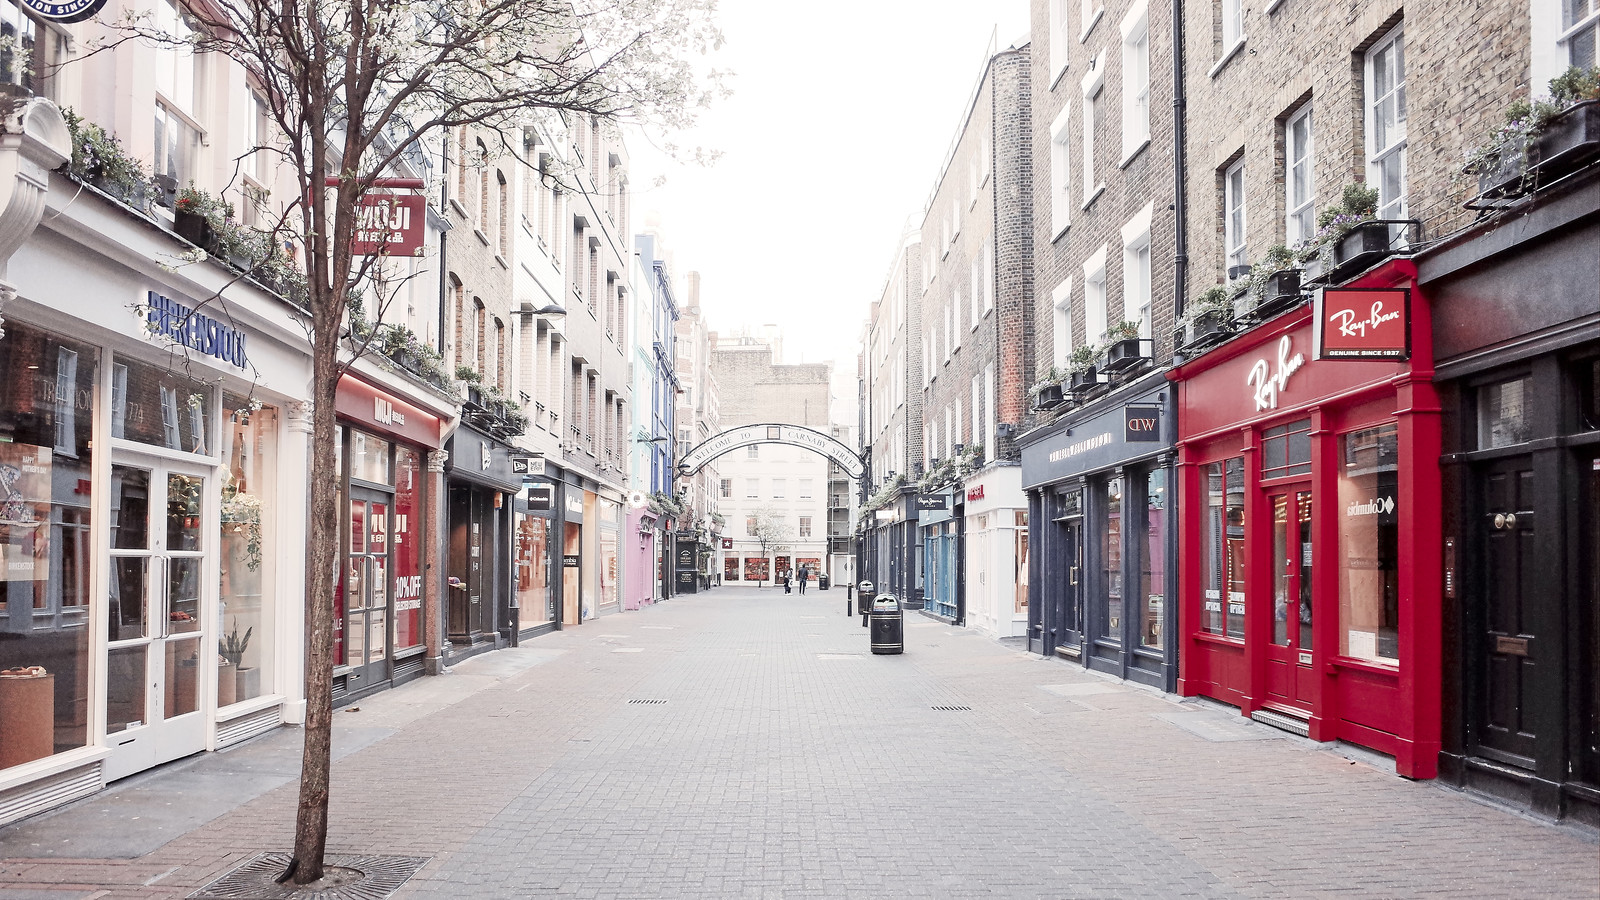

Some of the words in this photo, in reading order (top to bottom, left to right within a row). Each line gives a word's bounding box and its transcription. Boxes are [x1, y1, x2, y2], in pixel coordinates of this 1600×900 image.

[26, 0, 51, 13] ION
[57, 0, 90, 14] SINC
[353, 205, 411, 230] MUJI
[148, 290, 247, 370] BIRKENSTOCK
[1329, 300, 1400, 337] Ray-Ban
[1247, 334, 1305, 413] Ray-Ban
[374, 395, 392, 426] MUJI
[694, 436, 732, 461] WELCOME
[740, 432, 751, 441] TO
[788, 432, 828, 448] CARNABY
[831, 447, 858, 470] STREET
[395, 576, 410, 599] 10%
[410, 575, 421, 597] OFF
